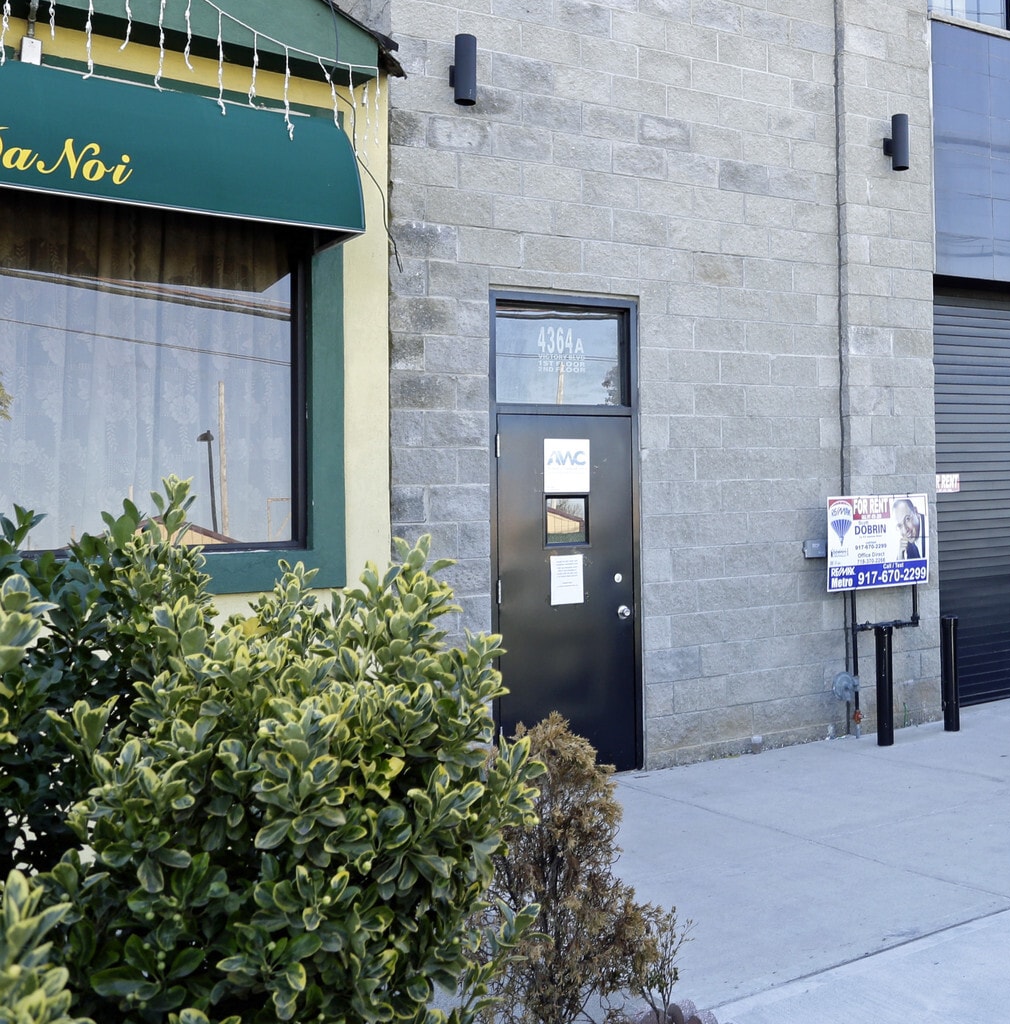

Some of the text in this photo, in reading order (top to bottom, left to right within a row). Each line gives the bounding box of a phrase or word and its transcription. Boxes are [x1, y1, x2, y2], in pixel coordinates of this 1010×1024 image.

[0, 126, 133, 185] a Noi
[853, 497, 888, 515] FOR RENT
[854, 524, 887, 536] DOBRIN
[830, 566, 856, 577] RE/MAX
[857, 566, 926, 585] 917-670-2299
[831, 577, 853, 588] Metro
